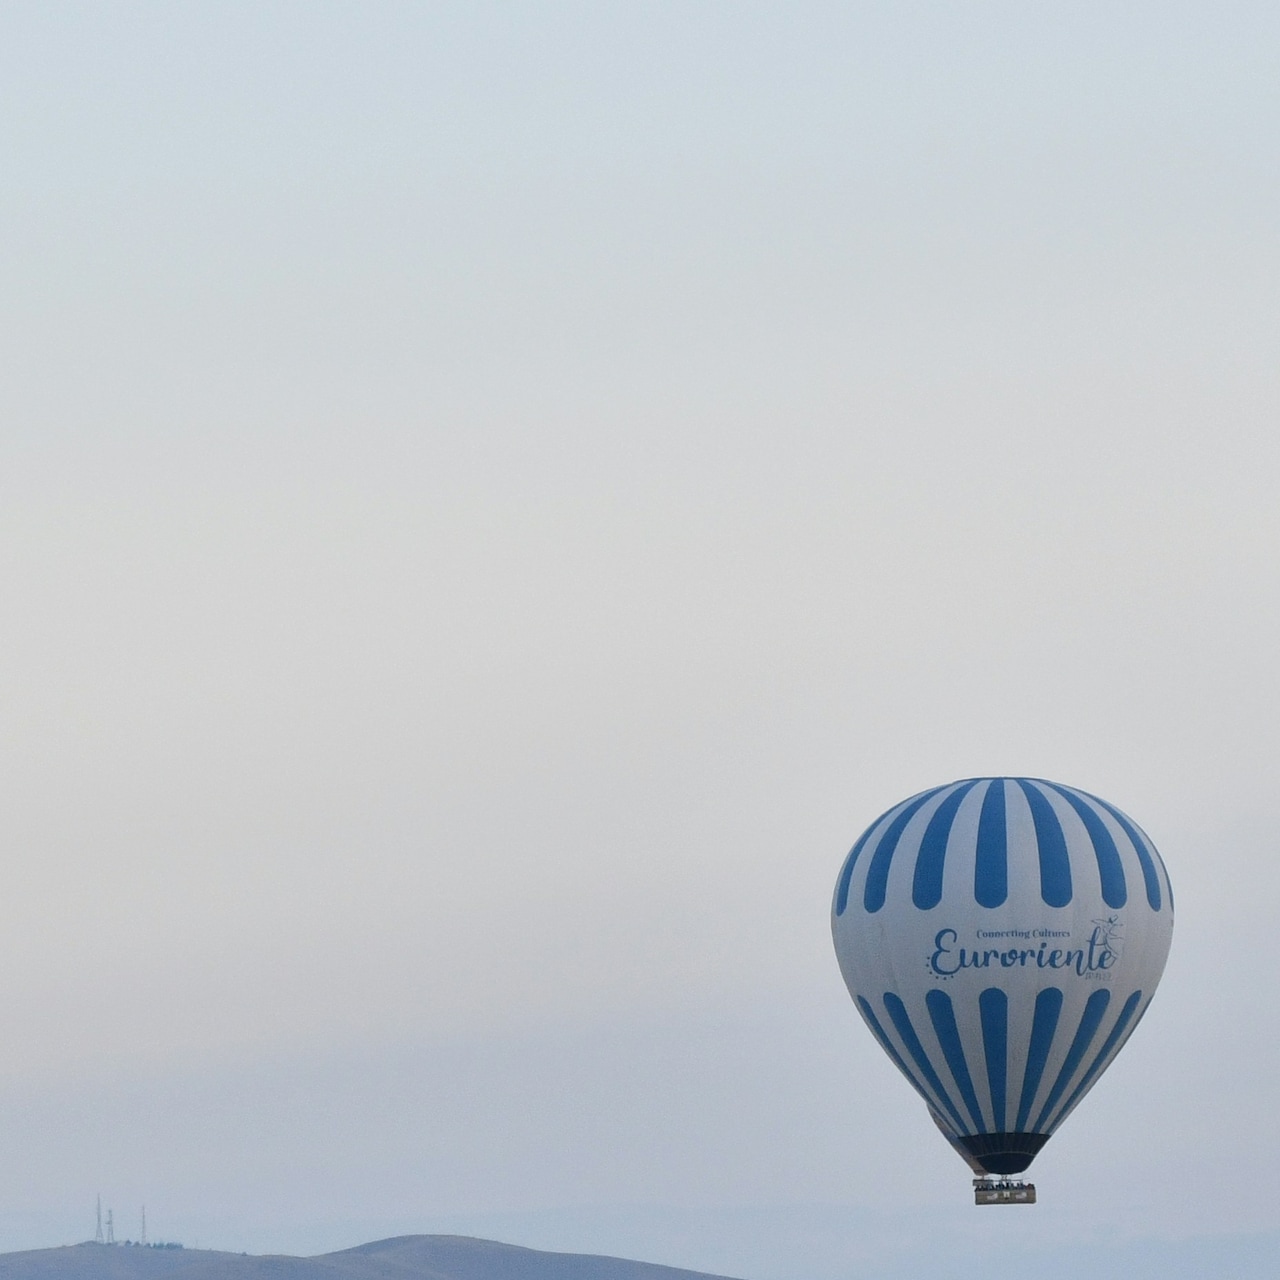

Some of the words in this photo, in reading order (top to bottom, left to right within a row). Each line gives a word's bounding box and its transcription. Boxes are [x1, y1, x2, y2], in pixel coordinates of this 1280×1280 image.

[976, 929, 1030, 939] Connecting
[1032, 928, 1070, 938] Cultures
[930, 927, 1116, 976] Euroriente
